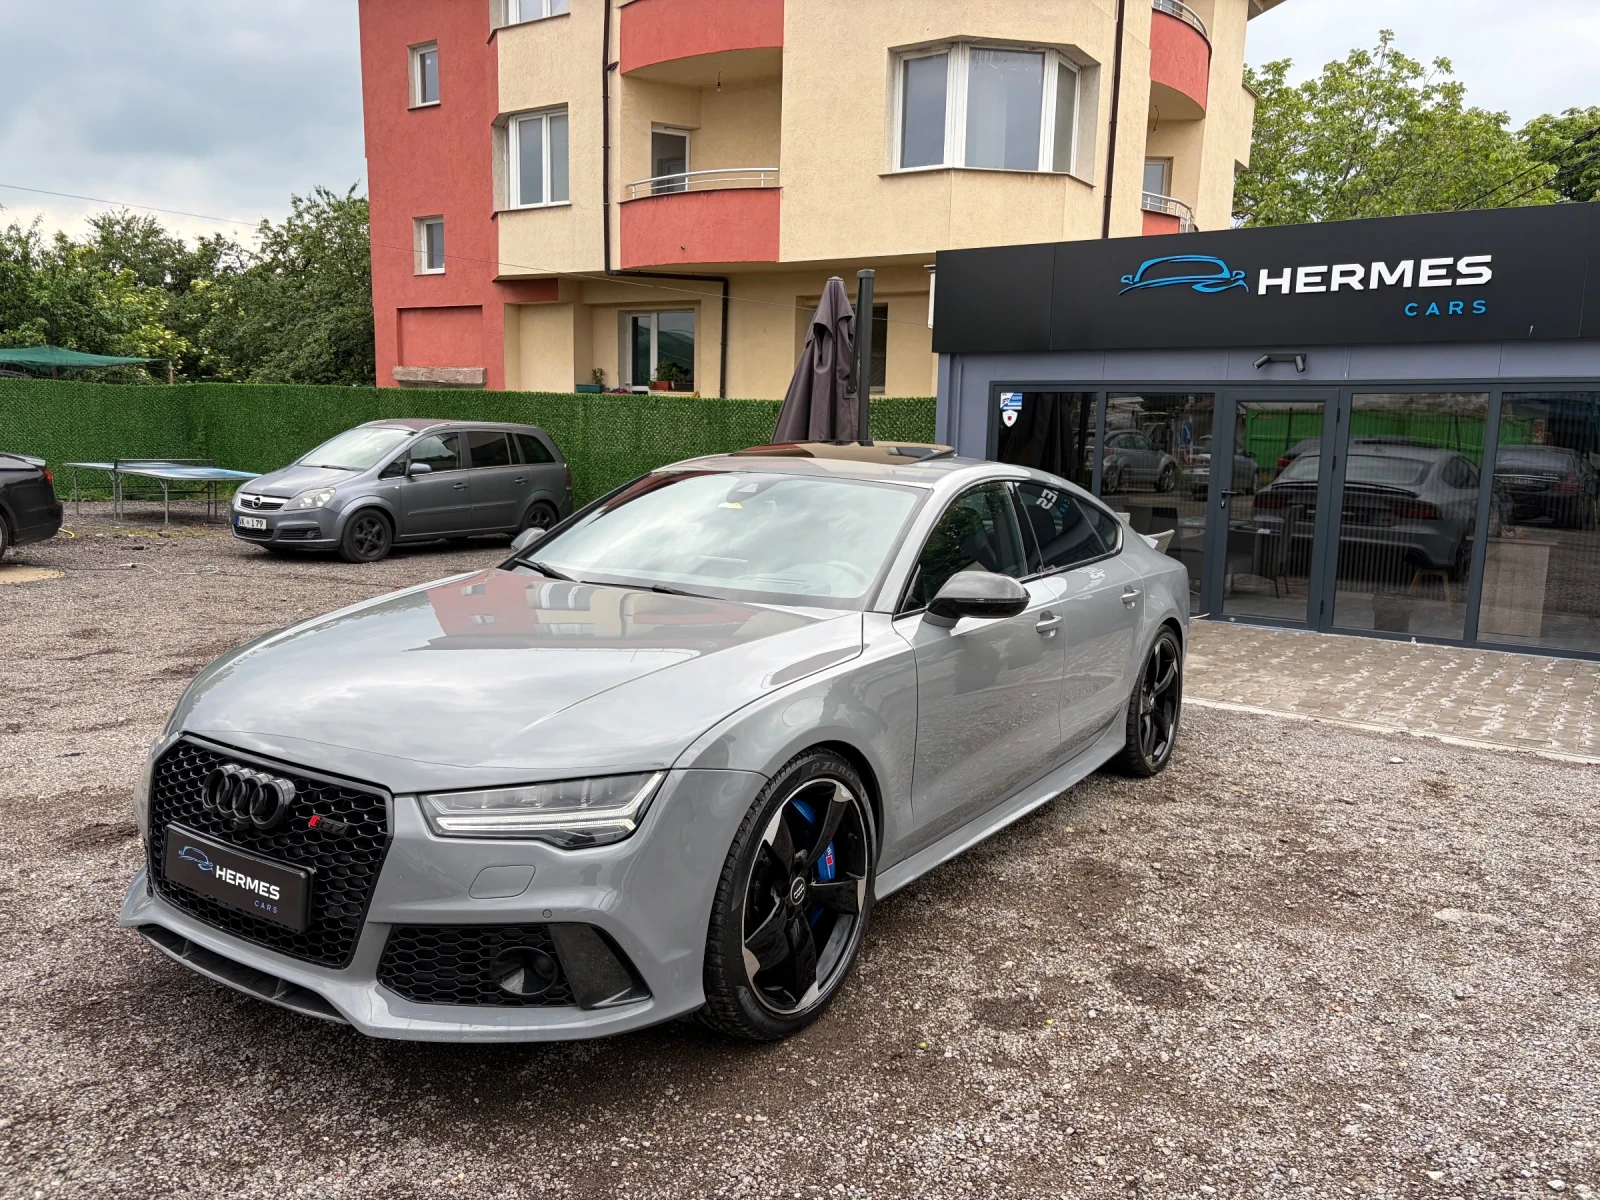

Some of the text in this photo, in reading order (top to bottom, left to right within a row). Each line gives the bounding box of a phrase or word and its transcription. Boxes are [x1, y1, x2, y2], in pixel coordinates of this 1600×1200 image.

[1257, 254, 1493, 295] HERMES
[1404, 299, 1487, 317] CARS
[821, 761, 855, 780] ZERO
[215, 864, 281, 901] HERMES
[253, 900, 279, 914] CARS
